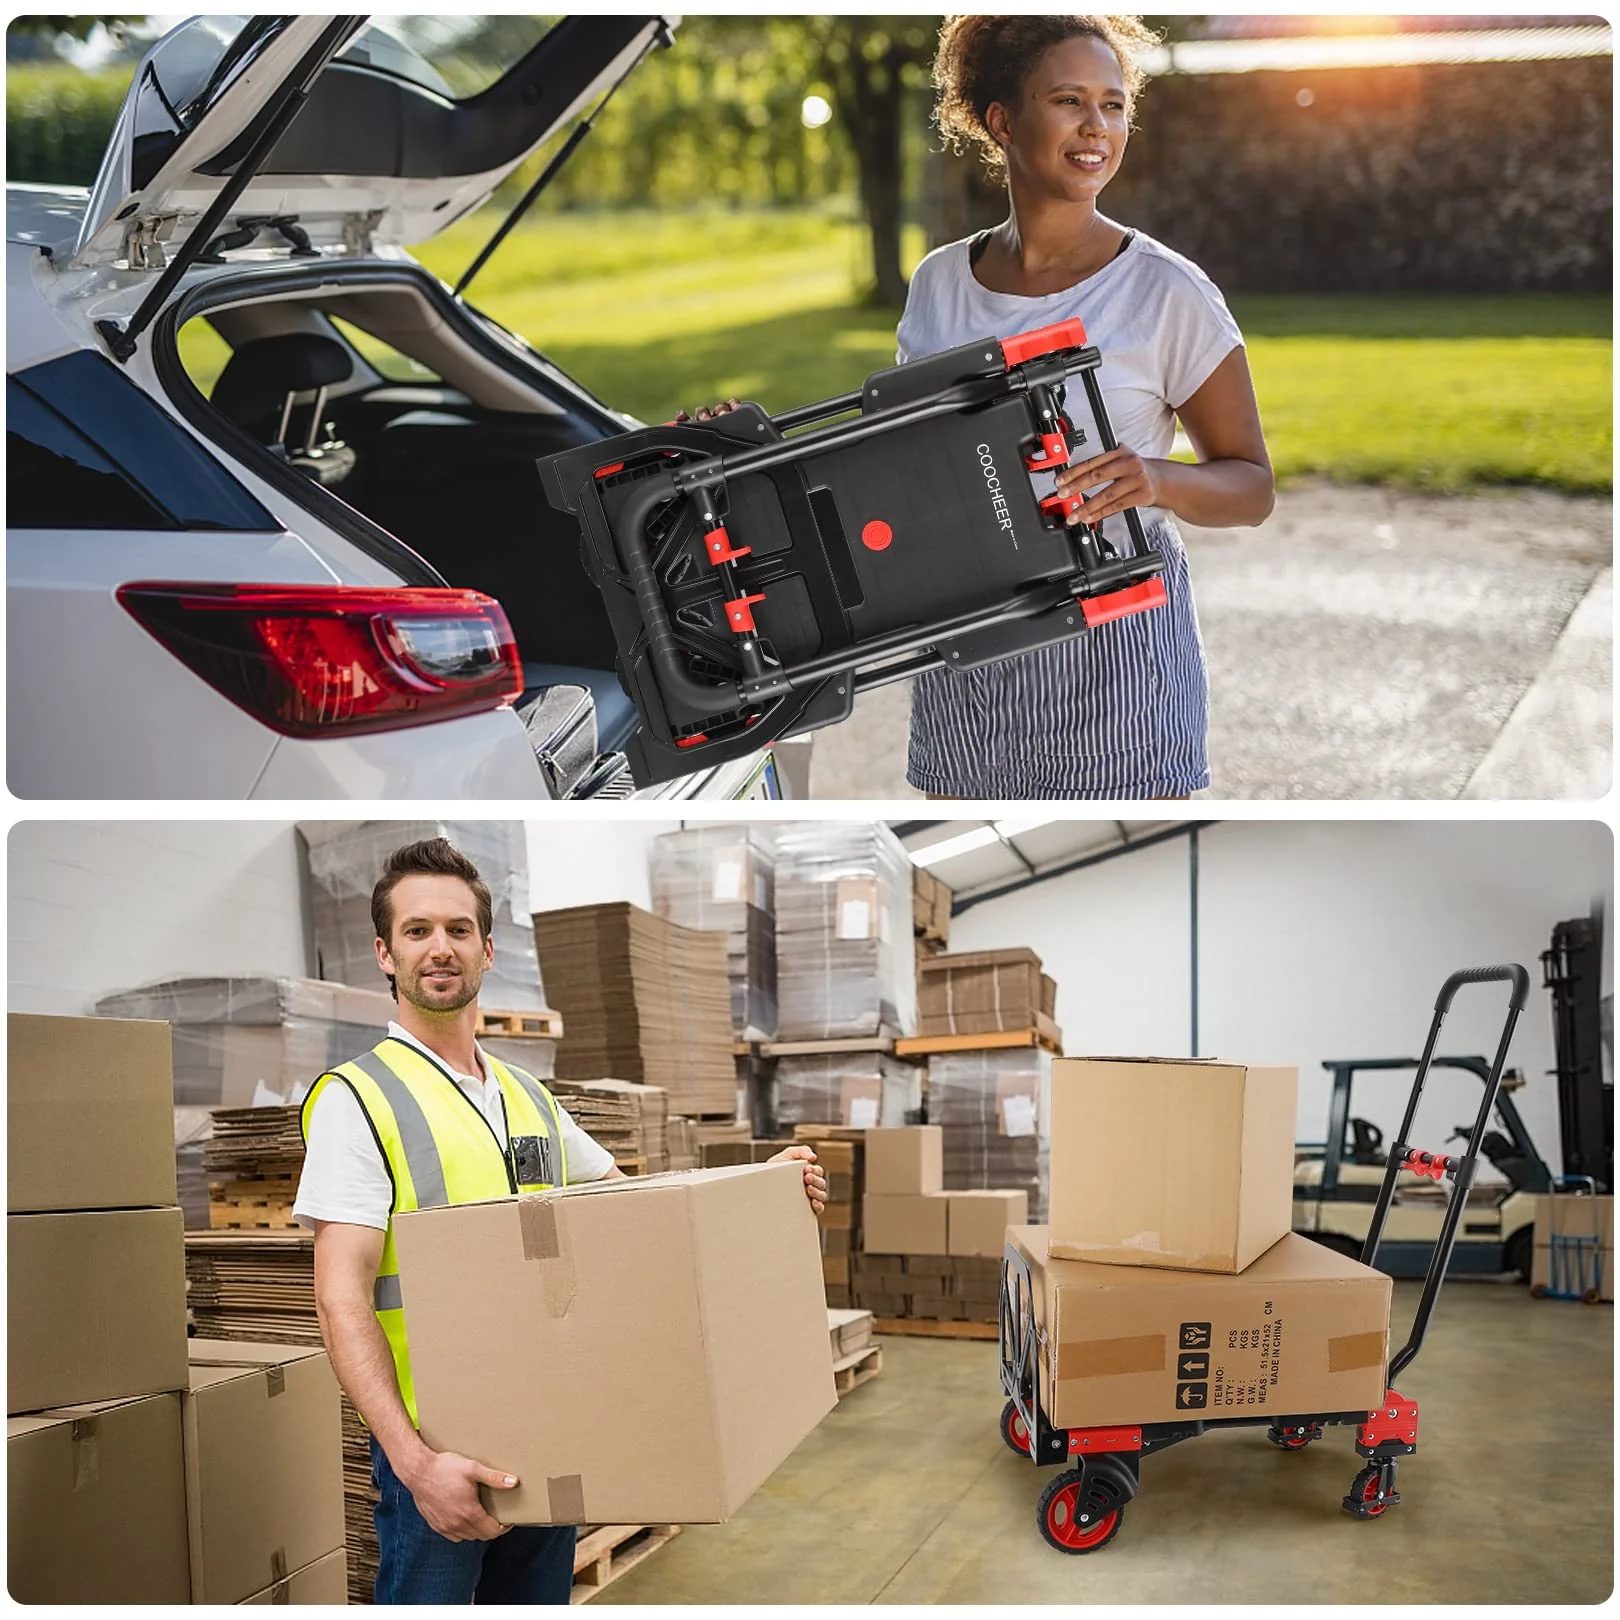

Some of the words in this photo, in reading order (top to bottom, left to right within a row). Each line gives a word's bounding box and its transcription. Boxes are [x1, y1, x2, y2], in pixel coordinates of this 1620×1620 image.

[977, 443, 1012, 531] COOCHEER
[1264, 1301, 1272, 1315] CM
[1229, 1330, 1237, 1348] PCS
[1240, 1330, 1248, 1349] KGS
[1251, 1329, 1259, 1348] KGS
[1273, 1319, 1282, 1347] CHINA
[1272, 1348, 1279, 1358] IN
[1215, 1366, 1224, 1383] NO:
[1270, 1359, 1279, 1385] MADE
[1214, 1384, 1223, 1405] ITEM
